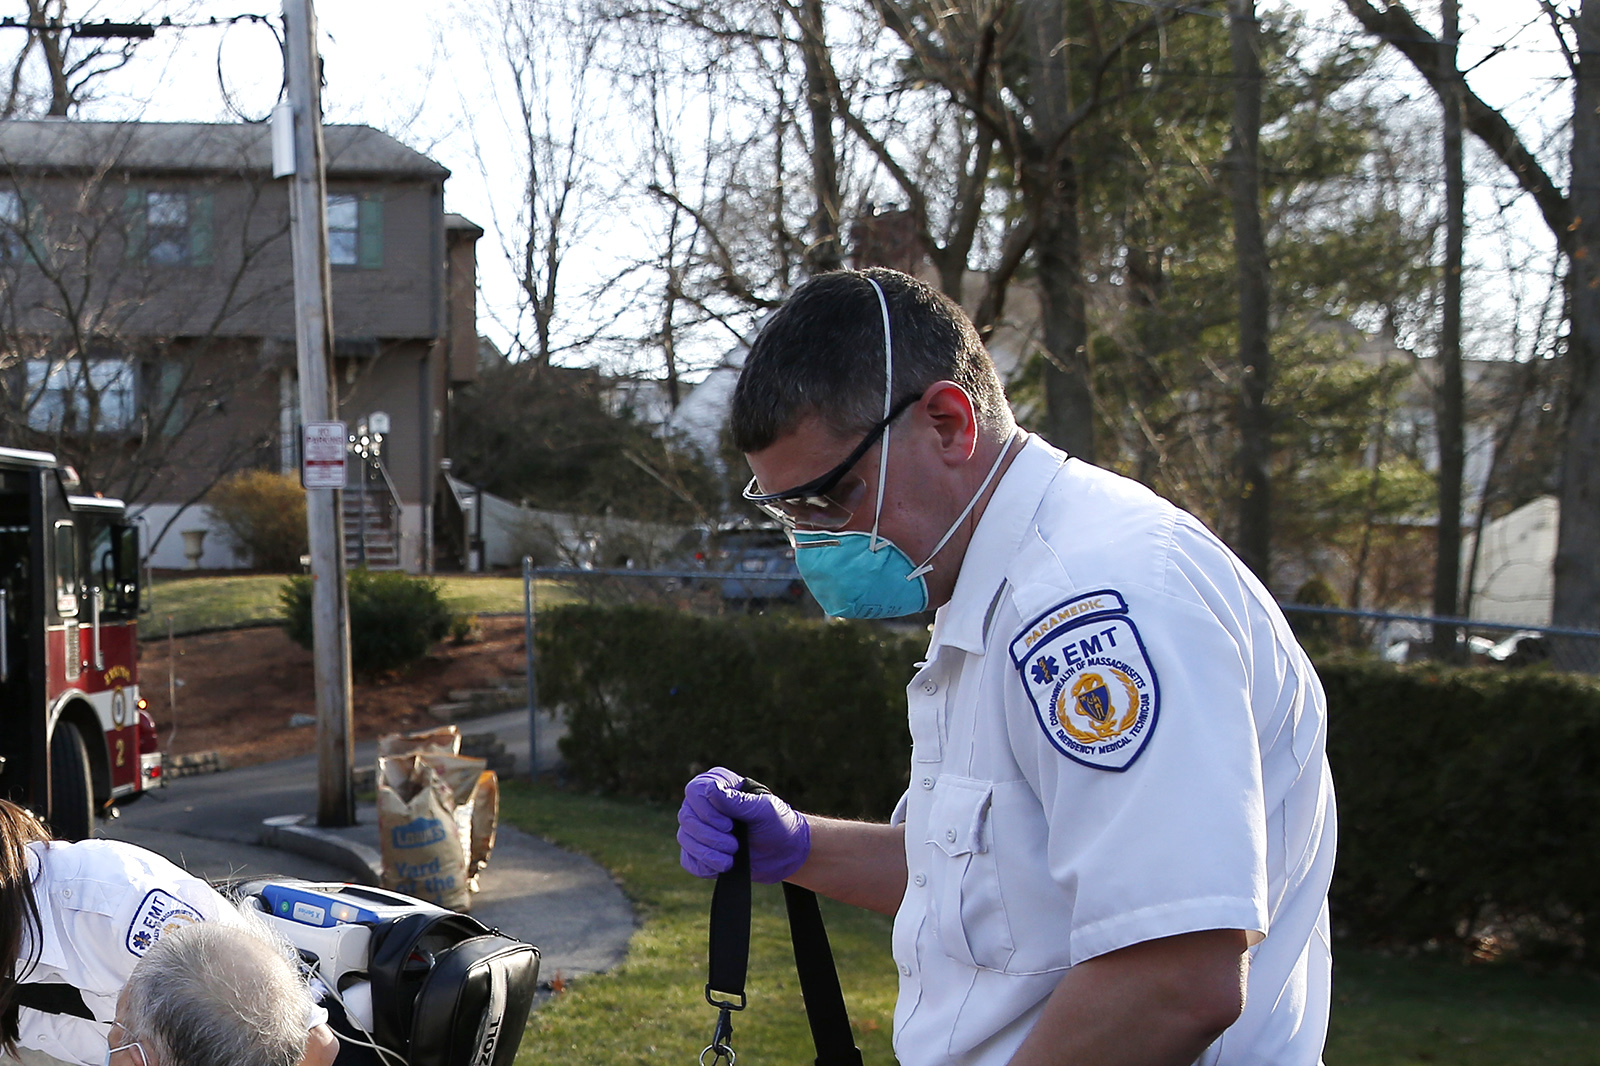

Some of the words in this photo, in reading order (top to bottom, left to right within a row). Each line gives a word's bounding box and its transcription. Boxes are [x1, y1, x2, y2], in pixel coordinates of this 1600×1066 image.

[1024, 599, 1105, 647] PARAMEDIC
[1062, 626, 1117, 666] EMT
[1049, 667, 1076, 726] COMMONWEALTH
[1075, 661, 1086, 671] OF
[1087, 657, 1146, 690] MASSACHUSETTS
[1056, 728, 1096, 754] EMERGENCY
[1098, 736, 1132, 755] MEDICAL
[1129, 693, 1150, 737] TECHNICIAN
[116, 739, 125, 768] 2
[396, 857, 440, 878] Yard
[424, 875, 455, 893] the
[143, 896, 165, 929] EMT
[479, 1016, 501, 1066] ZOLL
